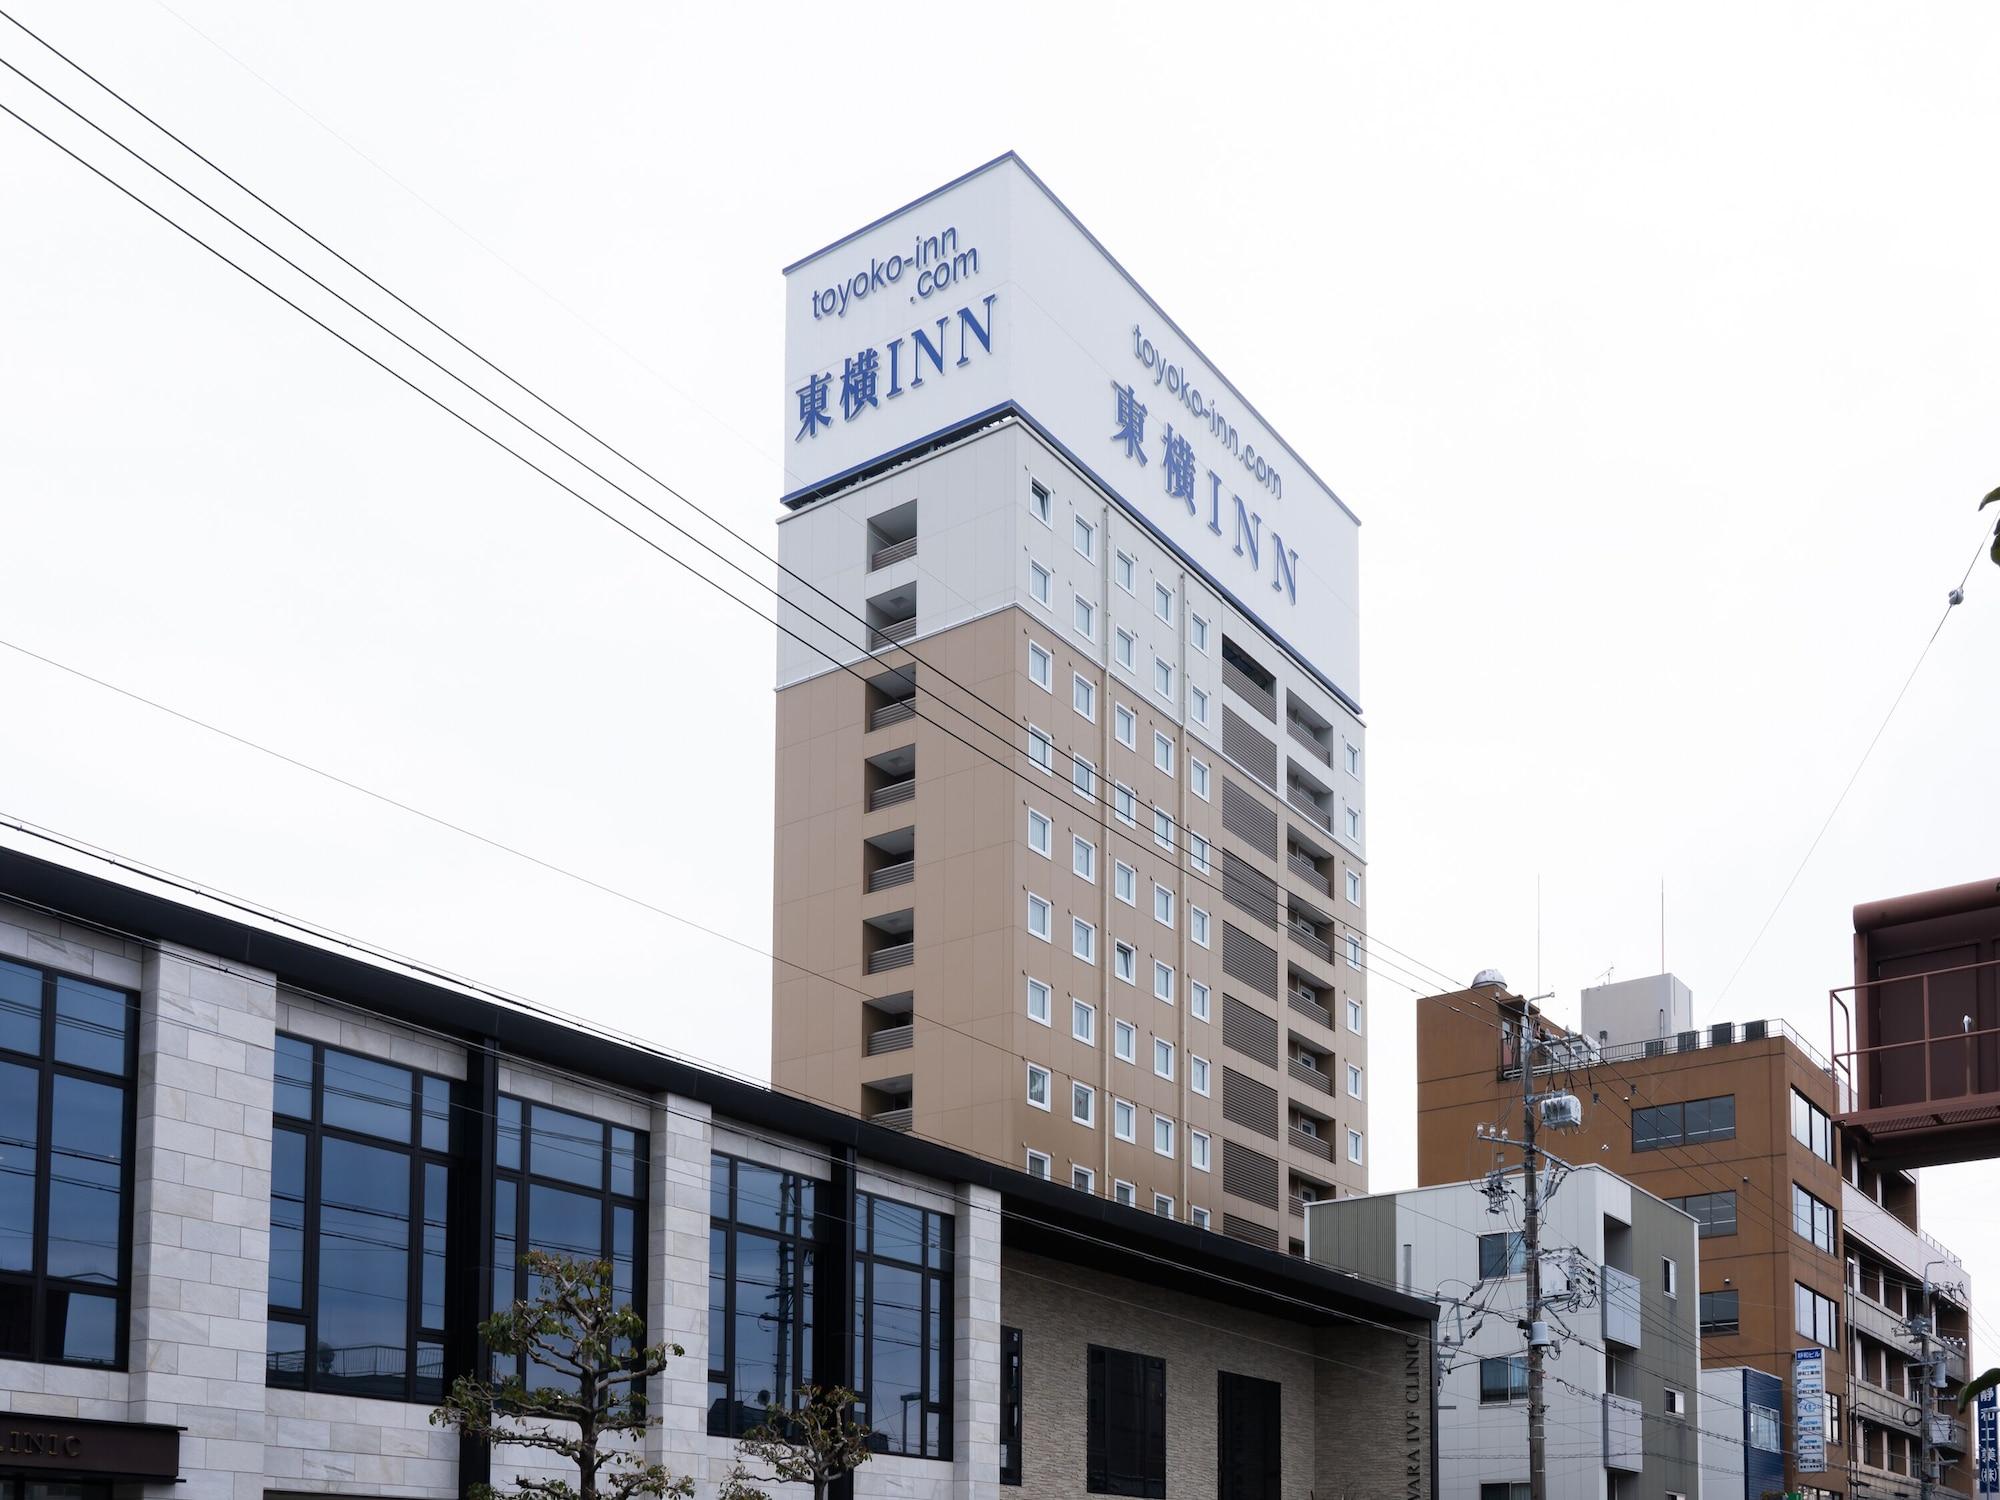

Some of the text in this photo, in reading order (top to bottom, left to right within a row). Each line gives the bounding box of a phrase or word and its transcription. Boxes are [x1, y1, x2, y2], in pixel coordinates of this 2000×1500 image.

[812, 226, 959, 320] toyoko-inn
[910, 247, 980, 304] .com
[795, 293, 998, 442] 東横INN
[1132, 324, 1282, 500] toyoko-inn.com
[1111, 379, 1299, 606] 東横INN
[1405, 1336, 1420, 1404] CLINIC
[0, 1431, 81, 1457] INIC
[1407, 1409, 1420, 1443] IVF
